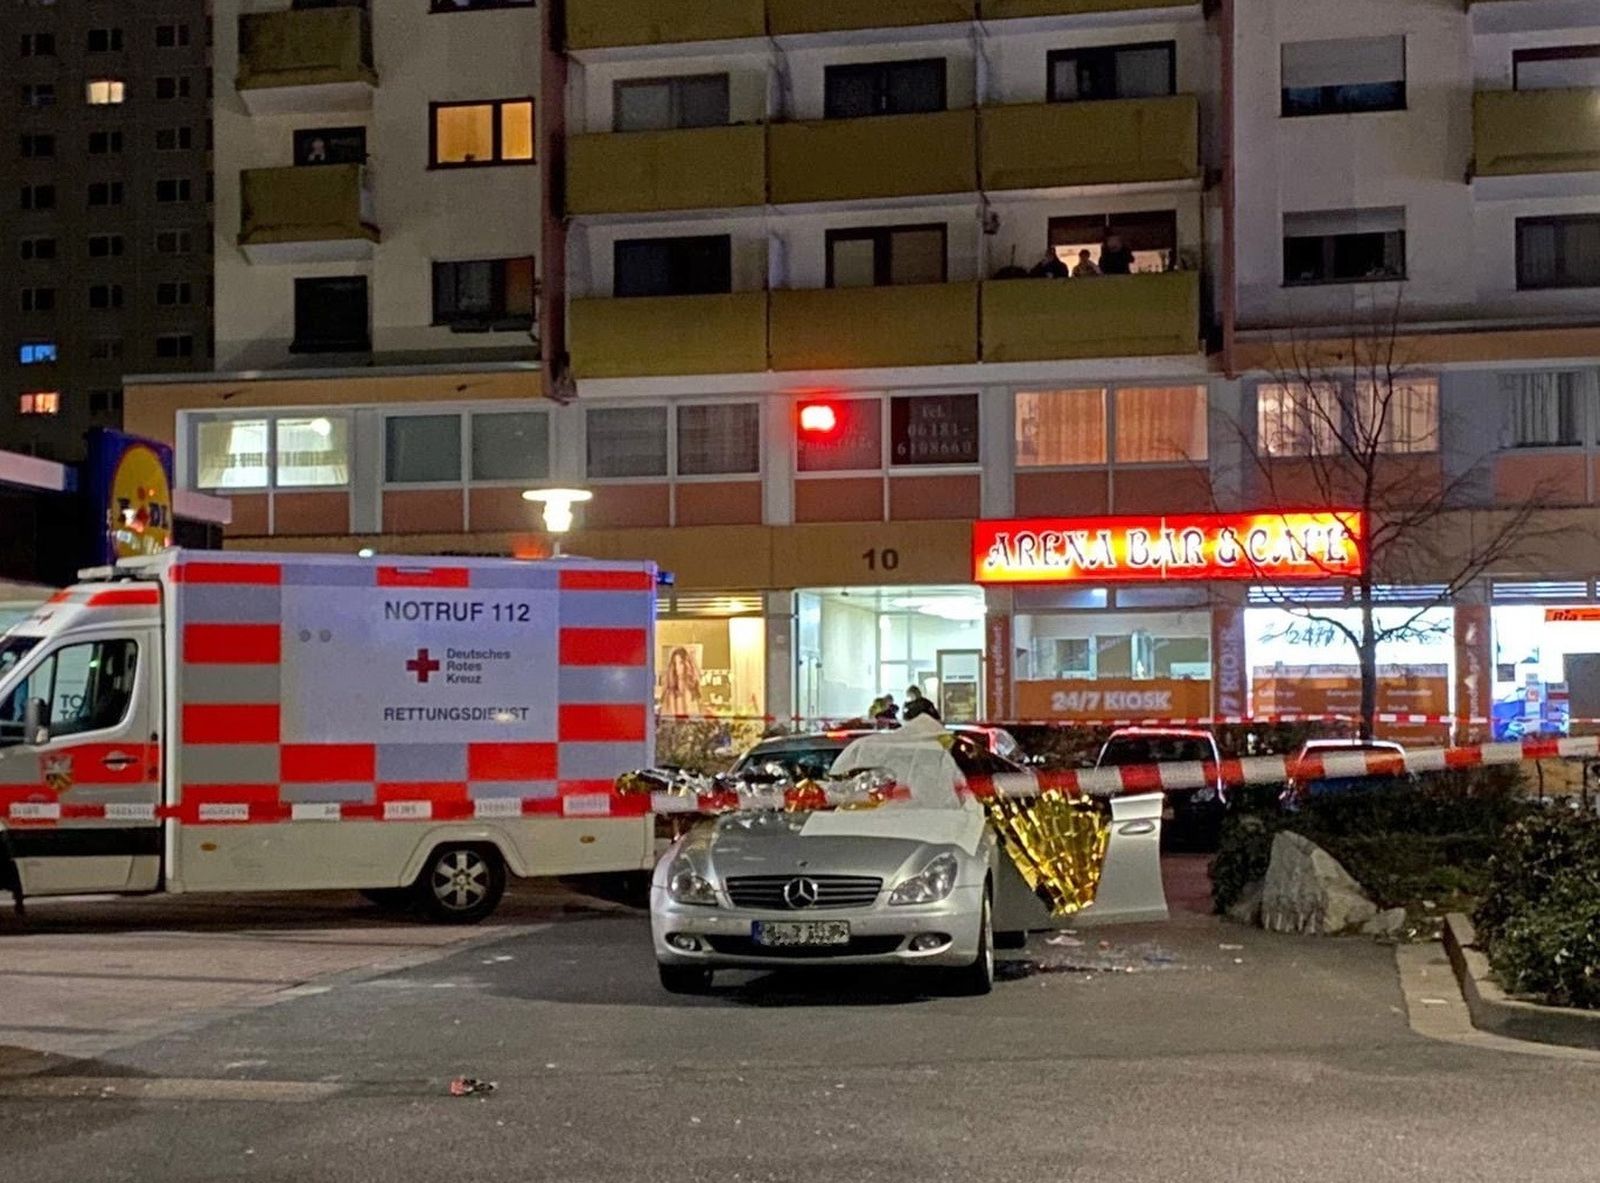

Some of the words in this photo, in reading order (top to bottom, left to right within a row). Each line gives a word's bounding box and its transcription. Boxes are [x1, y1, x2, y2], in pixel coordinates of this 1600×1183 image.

[986, 529, 1116, 568] ARENA
[1129, 529, 1204, 566] BAR
[862, 548, 899, 571] 10
[385, 601, 484, 622] NOTRUF
[492, 603, 530, 622] 112
[446, 649, 511, 660] Deutsches
[446, 662, 482, 672] Rotes
[446, 674, 482, 685] Kreuz
[1052, 690, 1099, 711] 24/7
[1102, 690, 1172, 711] KIOSK
